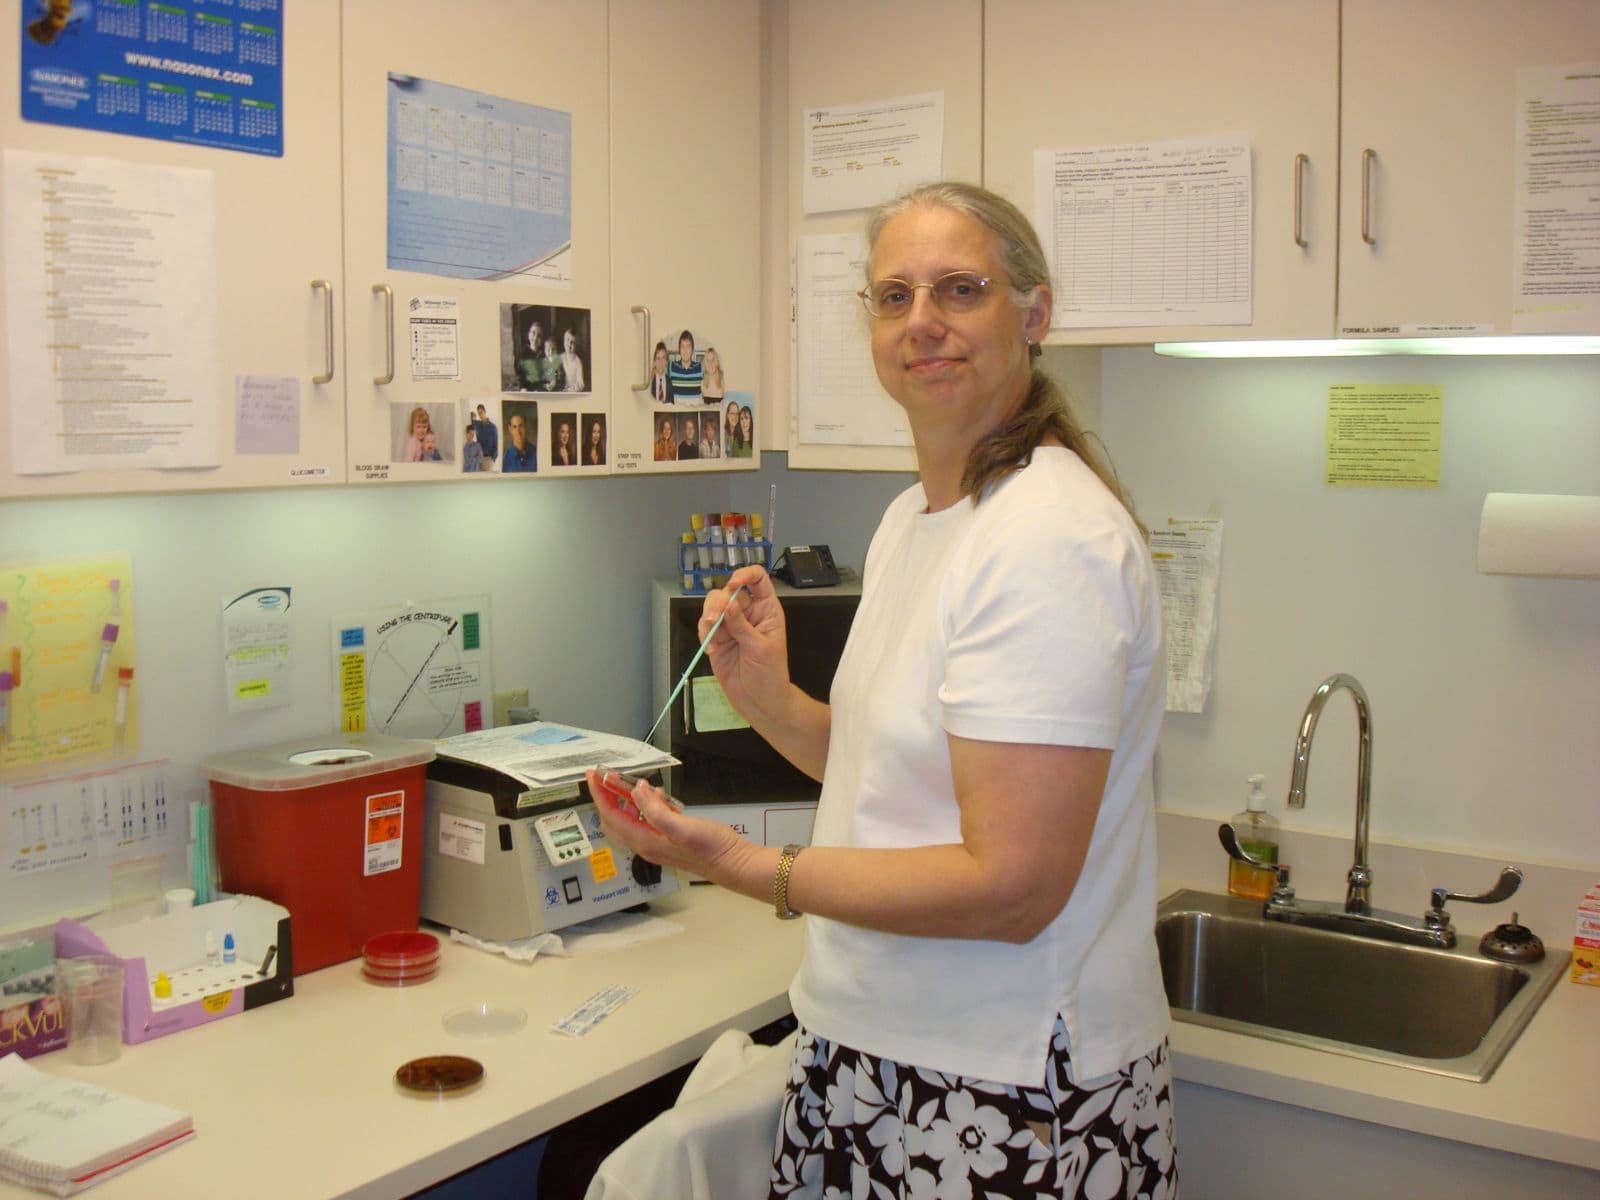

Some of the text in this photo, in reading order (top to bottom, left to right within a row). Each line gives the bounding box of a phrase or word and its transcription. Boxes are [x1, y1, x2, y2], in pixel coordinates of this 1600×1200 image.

[124, 51, 254, 87] www.nasonex.com
[290, 468, 325, 476] GLUCOMETER
[376, 612, 452, 635] USING THE CENTRIFUGE
